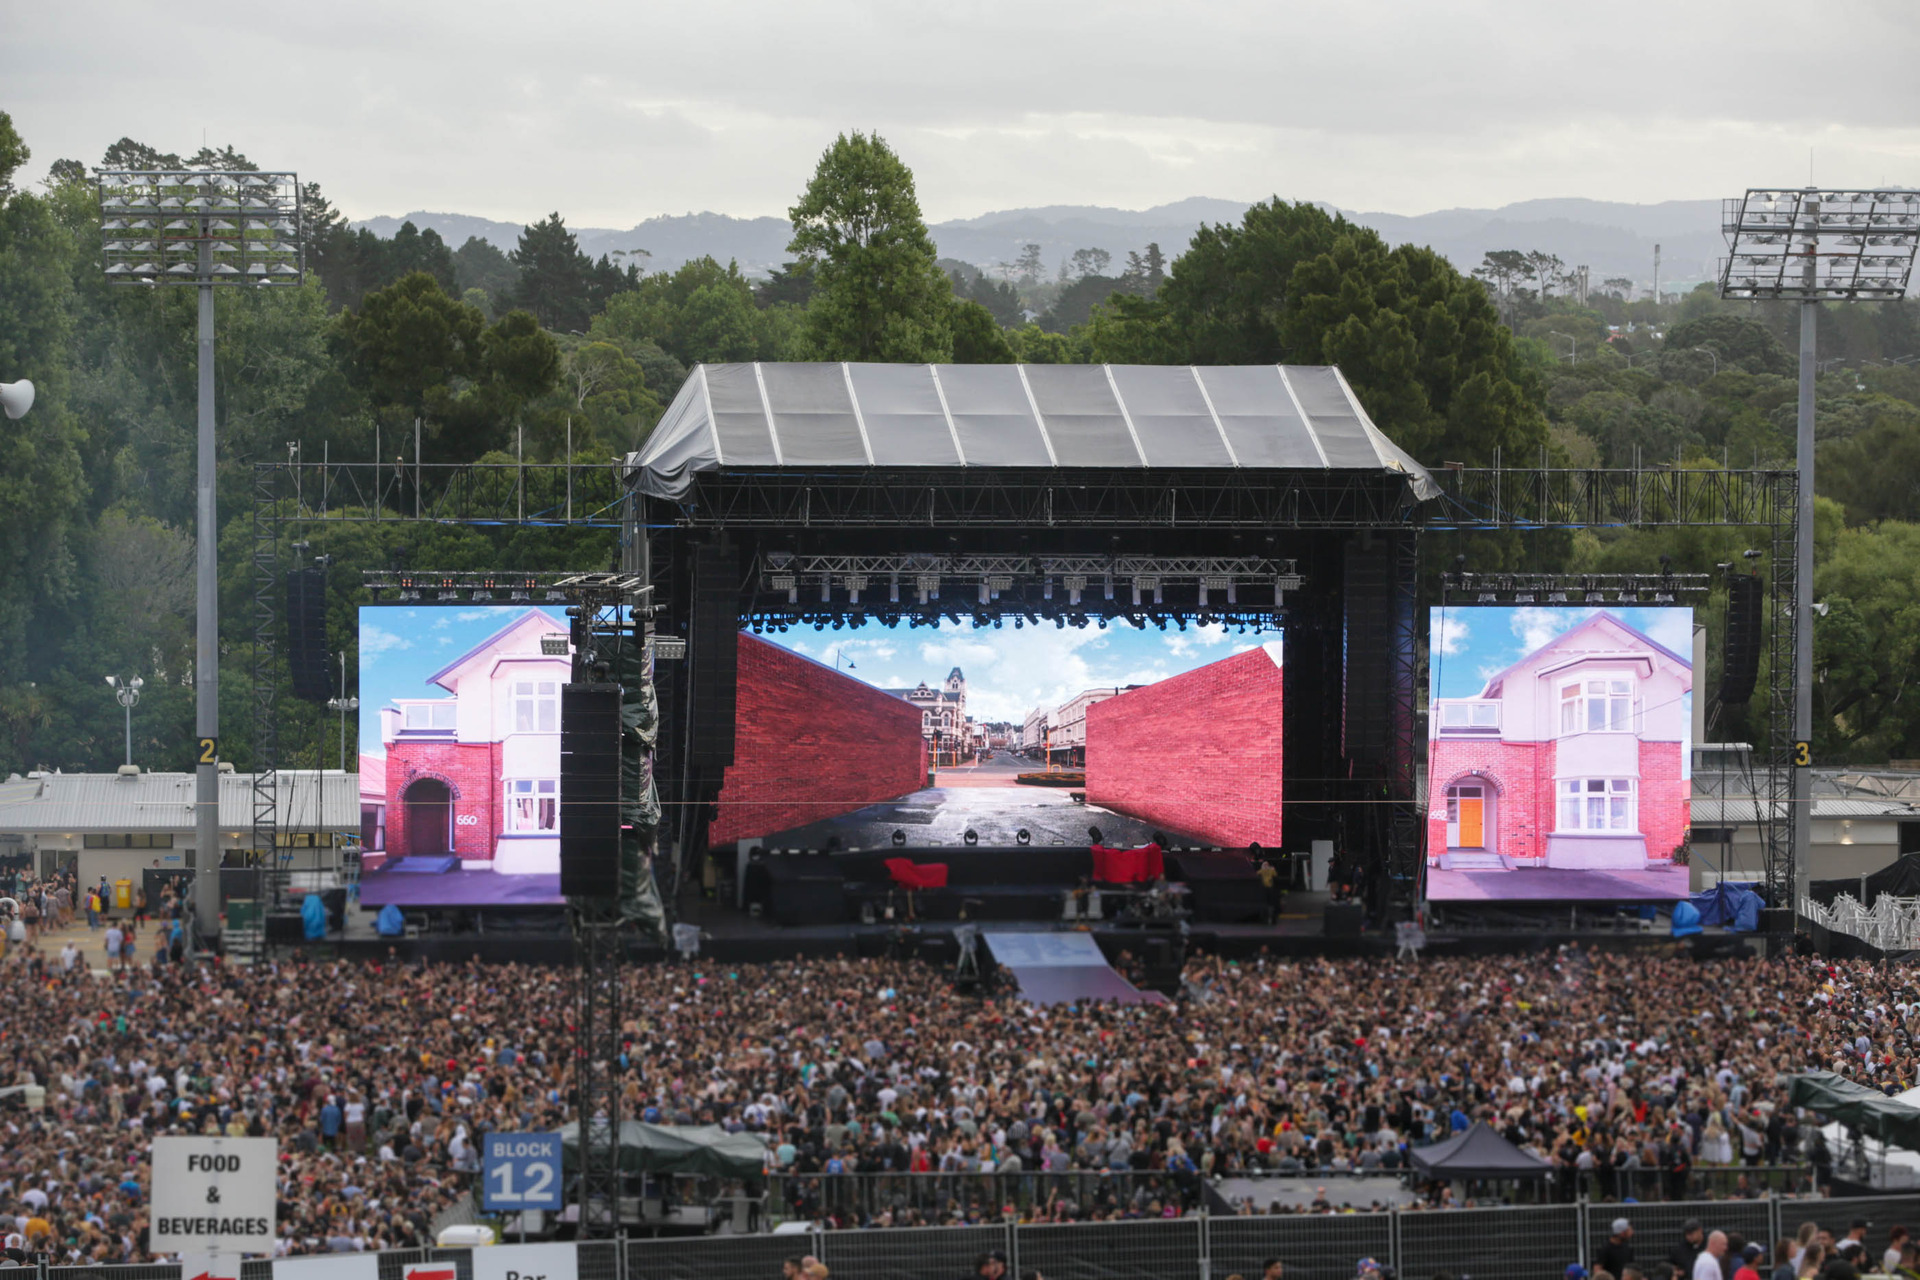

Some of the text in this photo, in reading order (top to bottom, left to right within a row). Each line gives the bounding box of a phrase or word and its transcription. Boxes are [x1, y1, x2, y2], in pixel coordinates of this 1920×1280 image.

[200, 739, 215, 762] 2
[1795, 742, 1809, 765] 3
[456, 815, 477, 825] 660
[493, 1142, 552, 1157] BLOCK
[188, 1154, 241, 1172] FOOD
[490, 1162, 554, 1201] 12
[206, 1186, 220, 1204] &
[157, 1217, 268, 1235] BEVERAGES
